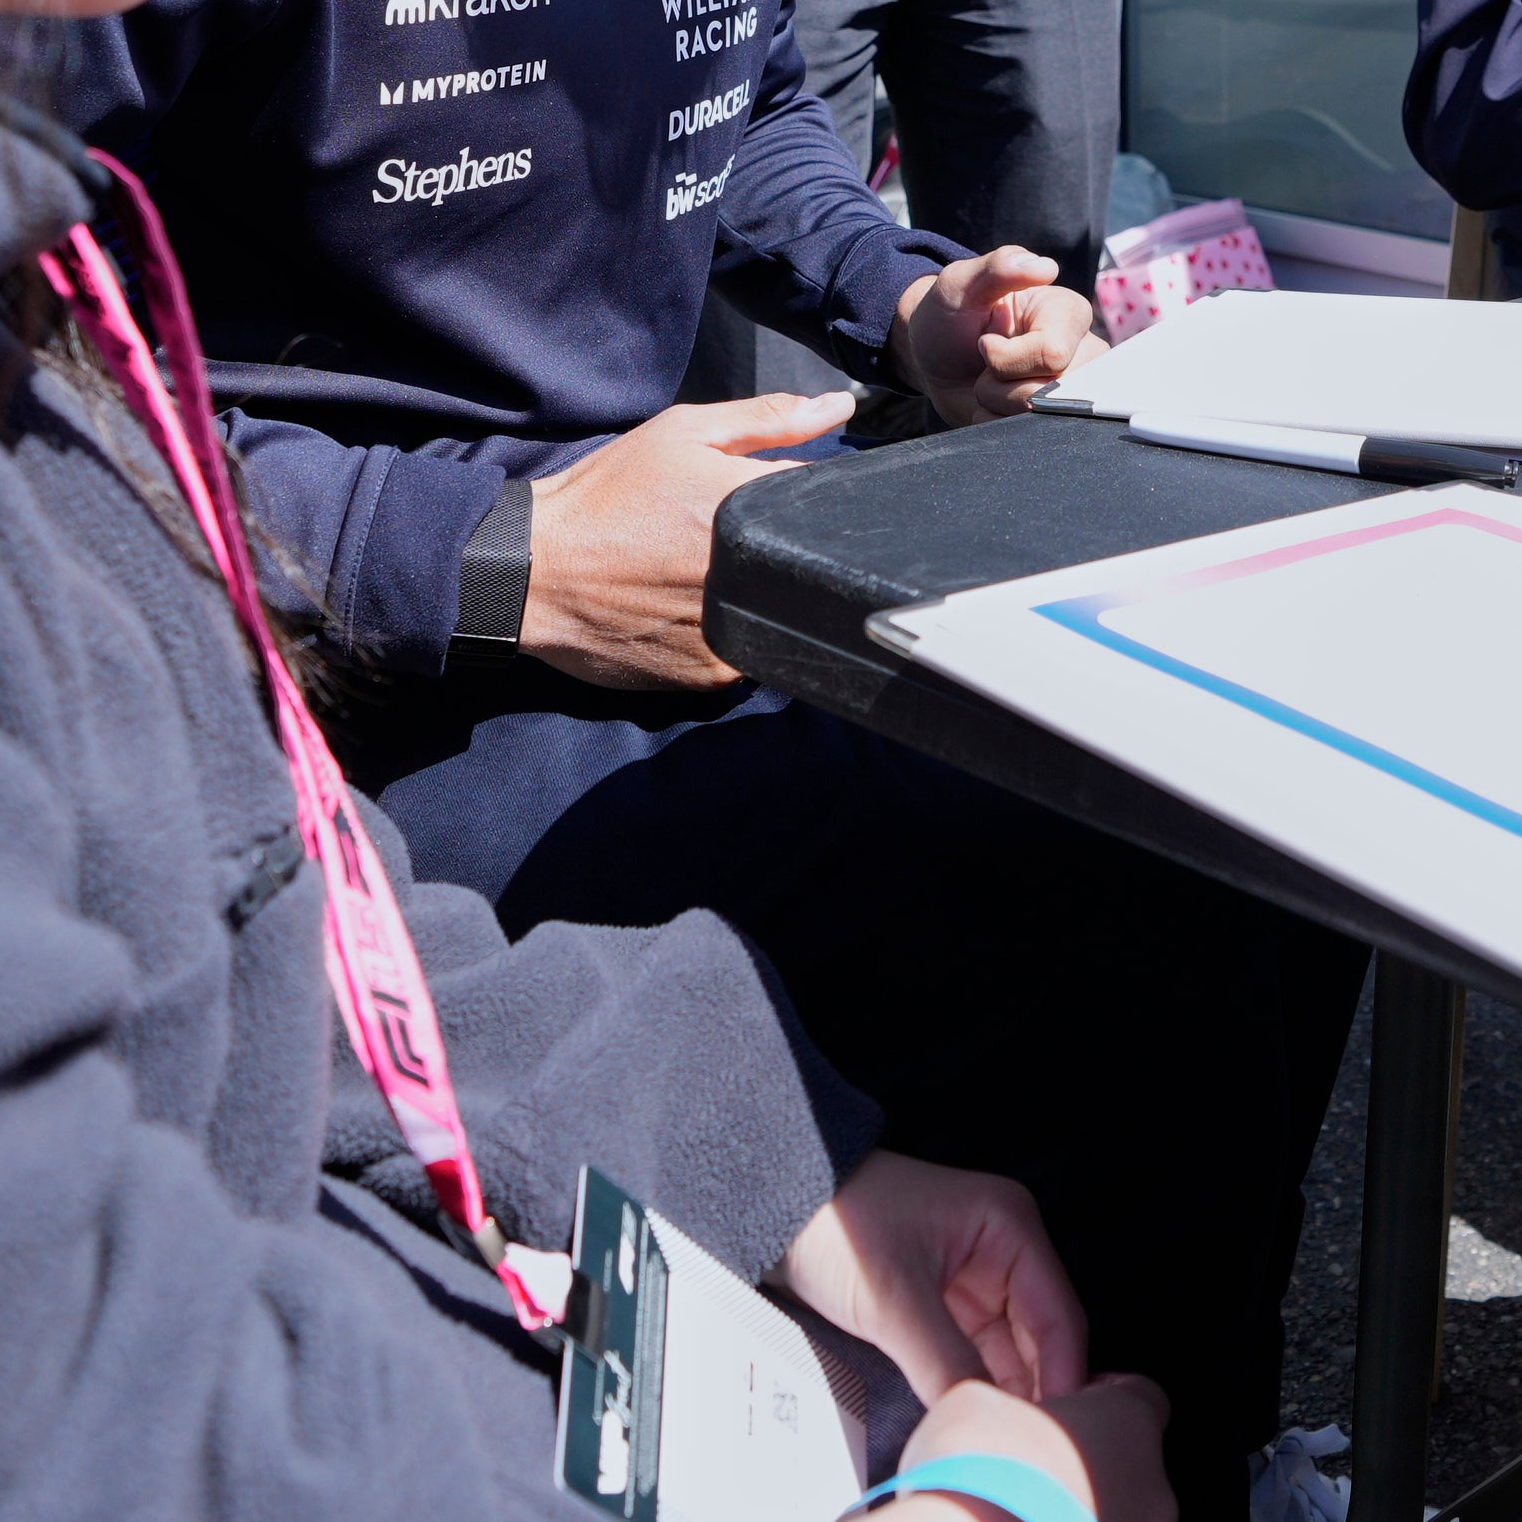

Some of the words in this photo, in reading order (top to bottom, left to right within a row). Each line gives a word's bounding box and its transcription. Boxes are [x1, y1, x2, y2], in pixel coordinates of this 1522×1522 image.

[675, 6, 759, 62] RACING
[411, 59, 548, 103] MYPROTEIN
[667, 78, 751, 142] DURACELL
[372, 146, 533, 207] Stephens
